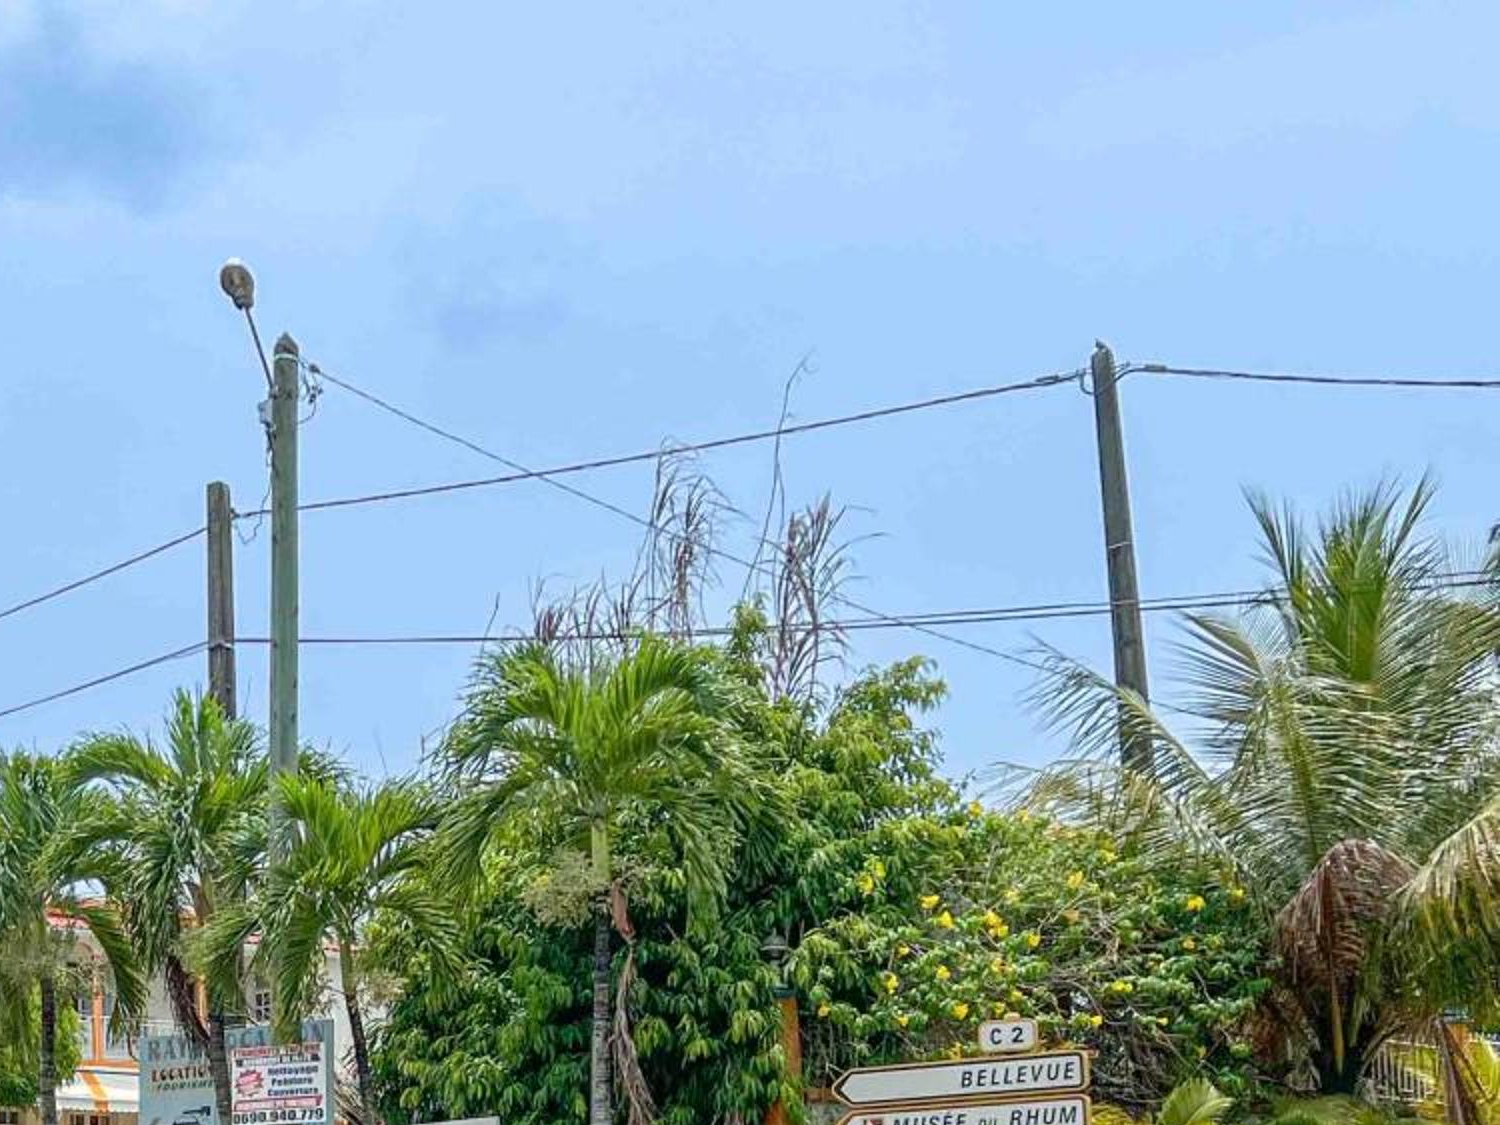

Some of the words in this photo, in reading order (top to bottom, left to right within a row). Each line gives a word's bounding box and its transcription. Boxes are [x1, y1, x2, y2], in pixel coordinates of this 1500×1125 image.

[990, 1028, 1002, 1045] C
[1011, 1026, 1025, 1044] 2
[961, 1061, 1076, 1088] BELLEVUE
